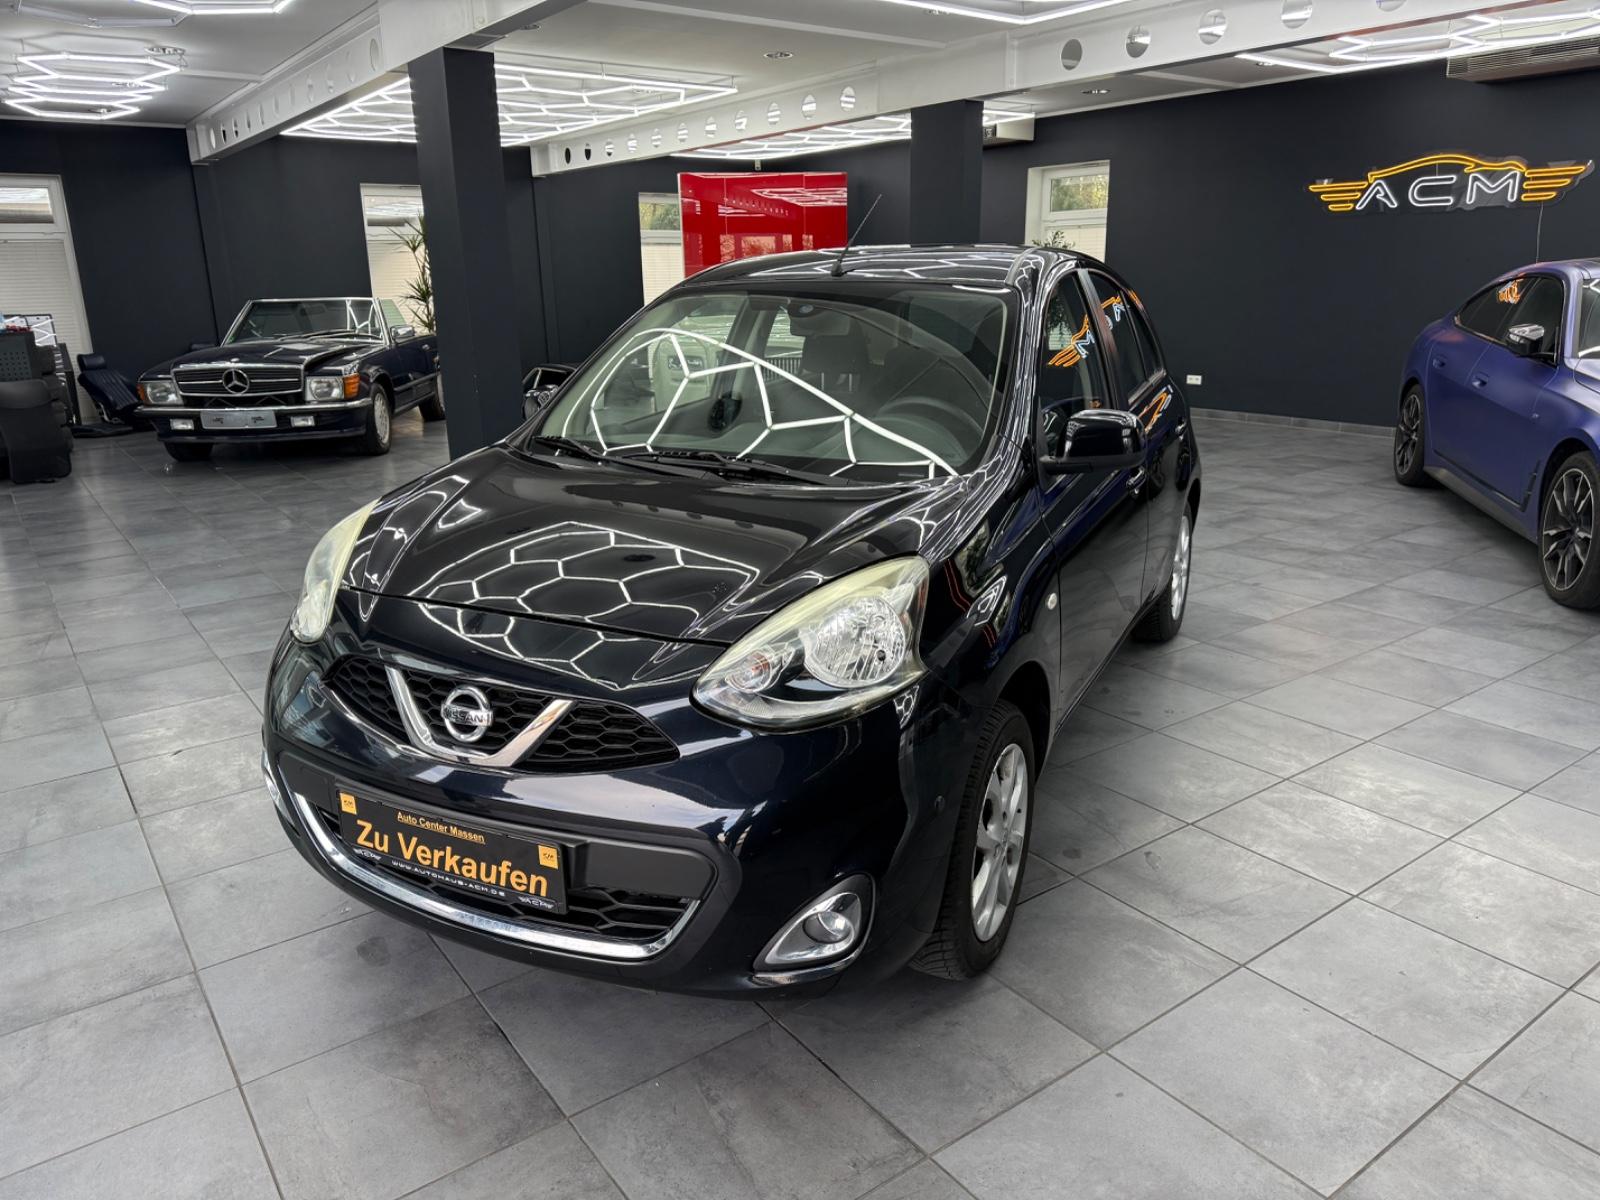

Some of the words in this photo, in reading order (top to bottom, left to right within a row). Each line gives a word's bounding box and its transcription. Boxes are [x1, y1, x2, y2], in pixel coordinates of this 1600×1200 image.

[1355, 170, 1520, 210] ACM
[397, 811, 418, 825] Auto
[418, 817, 448, 833] Center
[449, 825, 485, 843] Massen
[356, 819, 389, 853] Zu
[397, 831, 548, 897] Verkaufen
